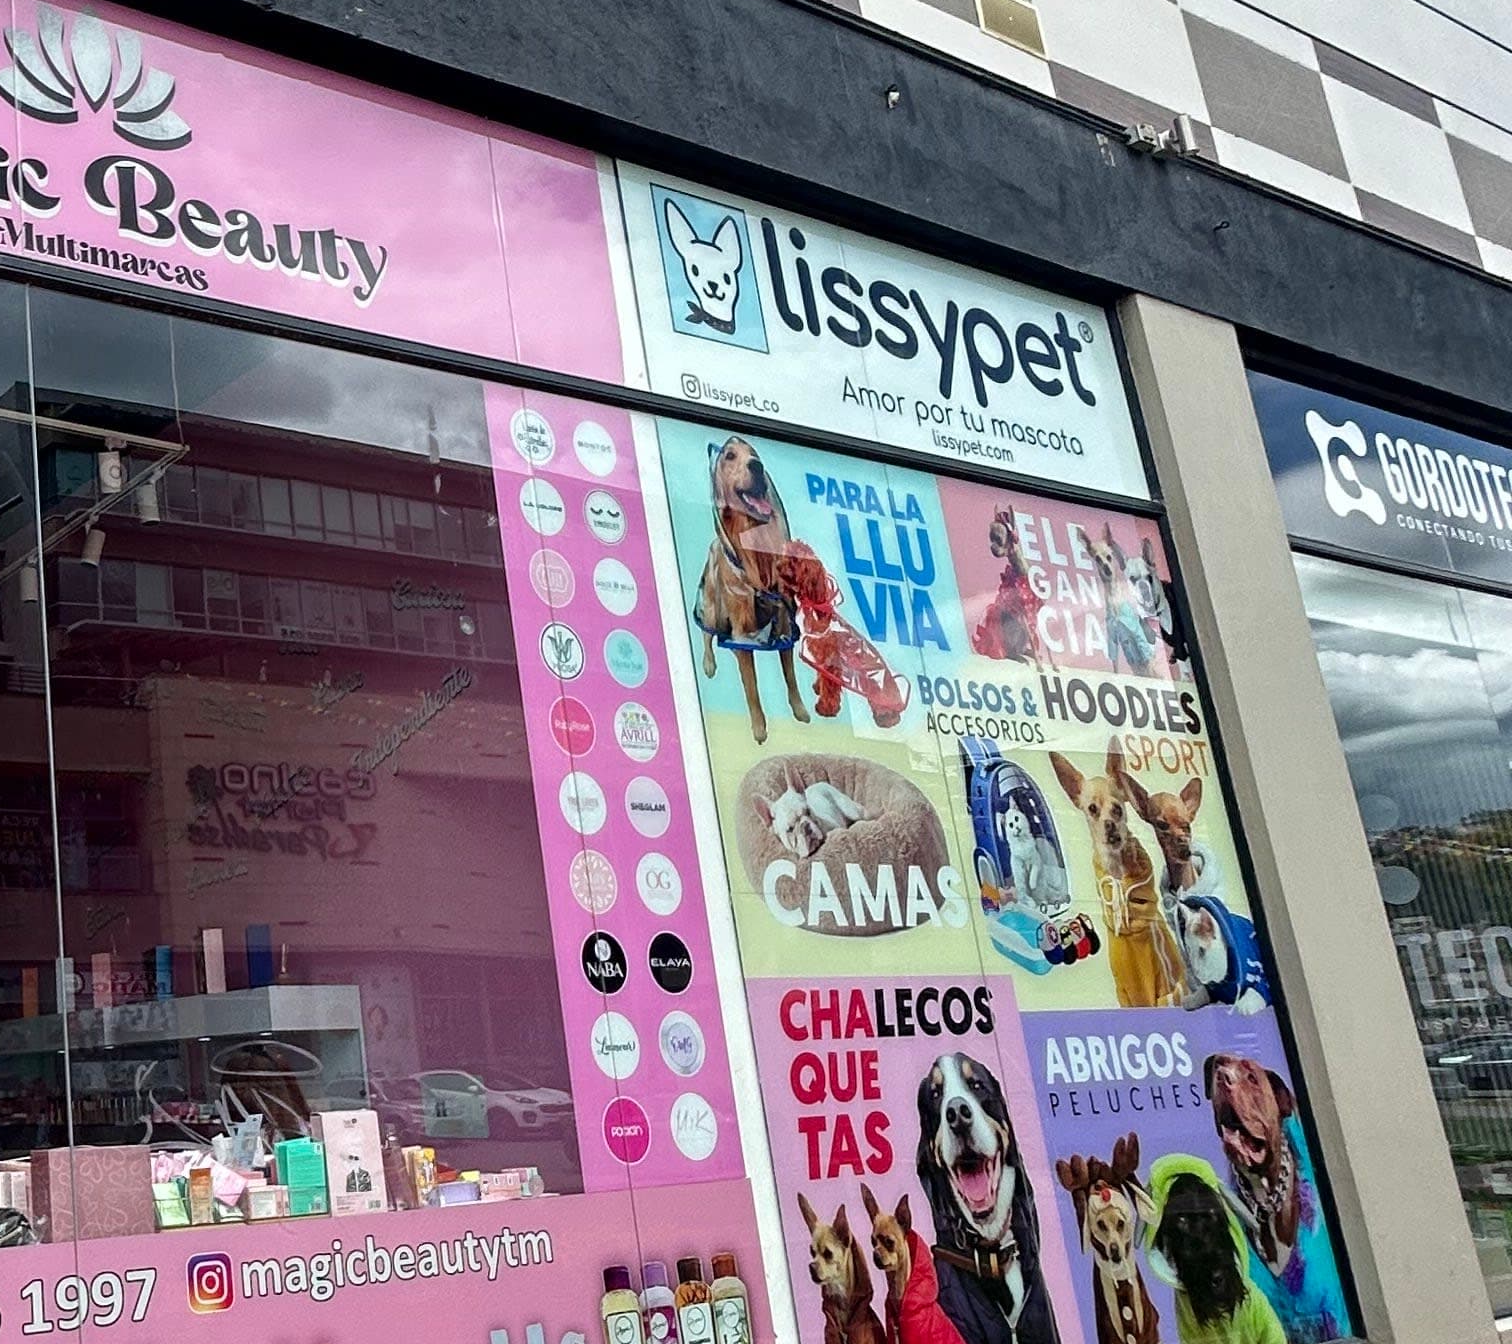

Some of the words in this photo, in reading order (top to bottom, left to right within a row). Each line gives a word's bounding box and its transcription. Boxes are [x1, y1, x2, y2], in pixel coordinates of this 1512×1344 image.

[84, 154, 390, 310] Beauty
[841, 375, 905, 417] Amor
[915, 400, 955, 427] por
[959, 403, 985, 433] tu
[990, 415, 1084, 457] mascota
[932, 429, 1015, 464] lissypet.com
[805, 471, 882, 518] PARA
[890, 488, 926, 525] LA
[834, 511, 937, 588] LLU
[1396, 513, 1486, 547] CONECTANDO
[847, 582, 952, 653] VIA
[1034, 605, 1111, 660] CIA
[916, 673, 1016, 716] BOLSOS
[1021, 689, 1039, 717] &
[1039, 674, 1203, 734] HOODIES
[926, 711, 1046, 745] ACCESORIOS
[1123, 733, 1211, 777] SPORT
[761, 857, 971, 930] CAMAS
[586, 961, 625, 979] NABA
[650, 956, 691, 969] ELAYA
[779, 986, 995, 1042] CHALECOS
[789, 1050, 881, 1107] QUE
[1045, 1030, 1194, 1085] ABRIGOS
[1048, 1082, 1203, 1119] PELUCHES
[797, 1110, 894, 1181] TAS
[241, 1224, 554, 1304] magicbeautytm
[19, 1268, 158, 1336] 1997
